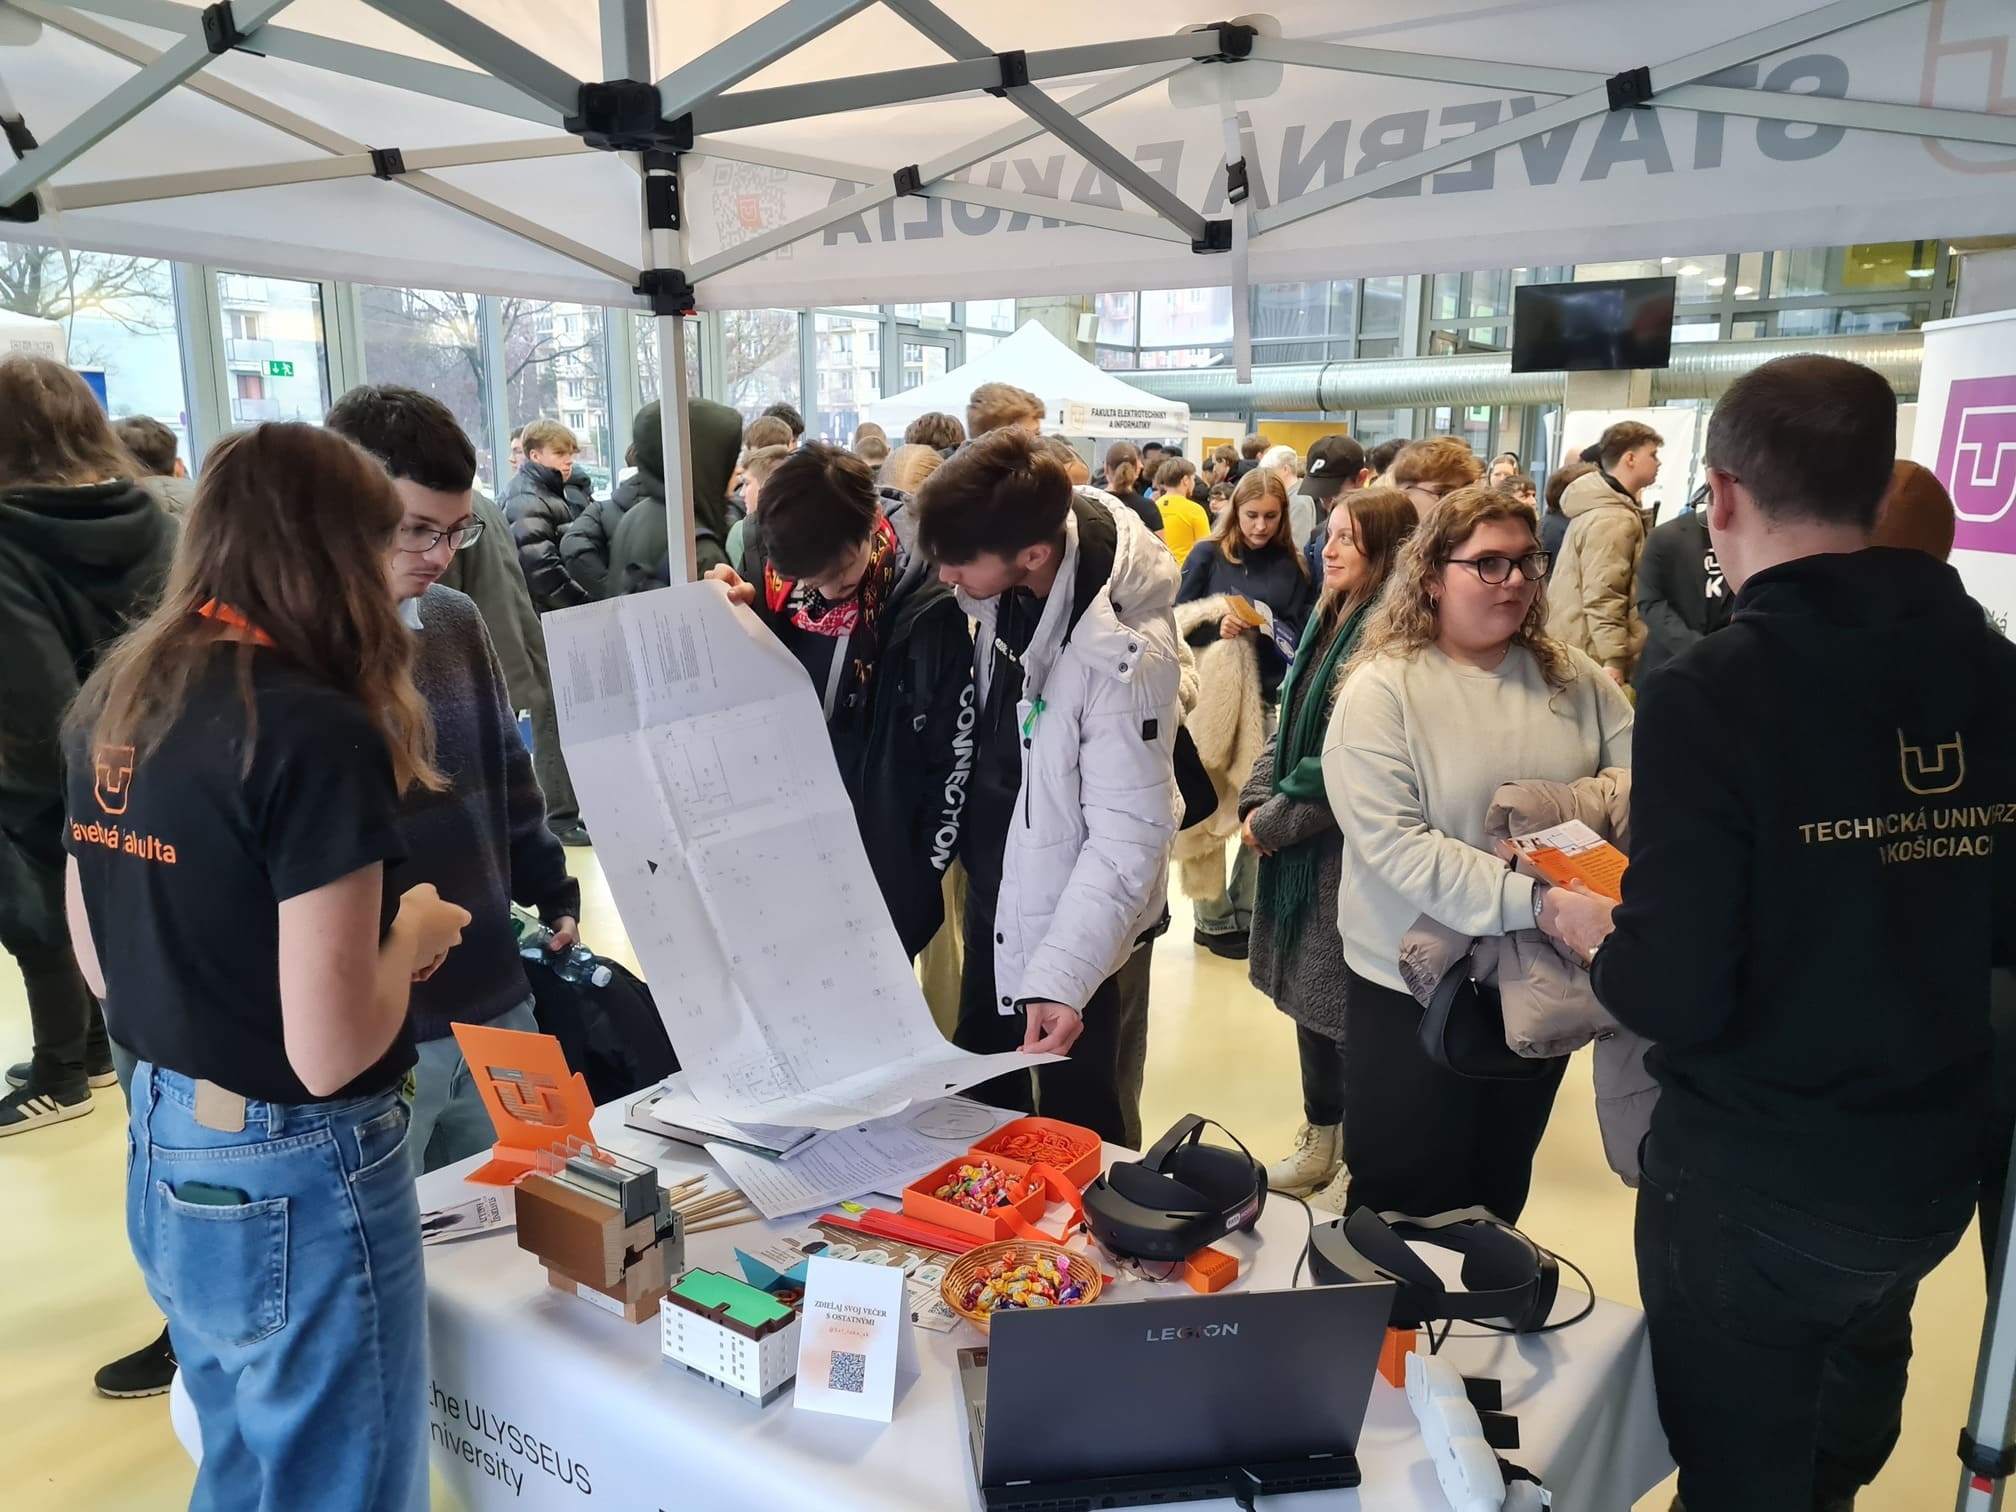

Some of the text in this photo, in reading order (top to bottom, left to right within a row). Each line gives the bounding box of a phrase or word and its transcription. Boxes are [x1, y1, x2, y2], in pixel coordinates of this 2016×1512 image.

[1091, 408, 1167, 419] FAKULTA ELEKTROTECHNIKY
[1114, 421, 1151, 429] INFORMATIKY
[1310, 459, 1326, 474] P
[930, 683, 975, 871] CONNECTION
[1799, 806, 1928, 843] TECHNCKÁ
[1887, 834, 1993, 864] KOŠICIAC
[831, 1314, 875, 1326] OSTATNÝMI
[844, 1304, 862, 1315] SVOJ
[863, 1307, 887, 1317] VEČER
[465, 1399, 592, 1495] ULYSSEUS
[431, 1421, 524, 1497] niversity
